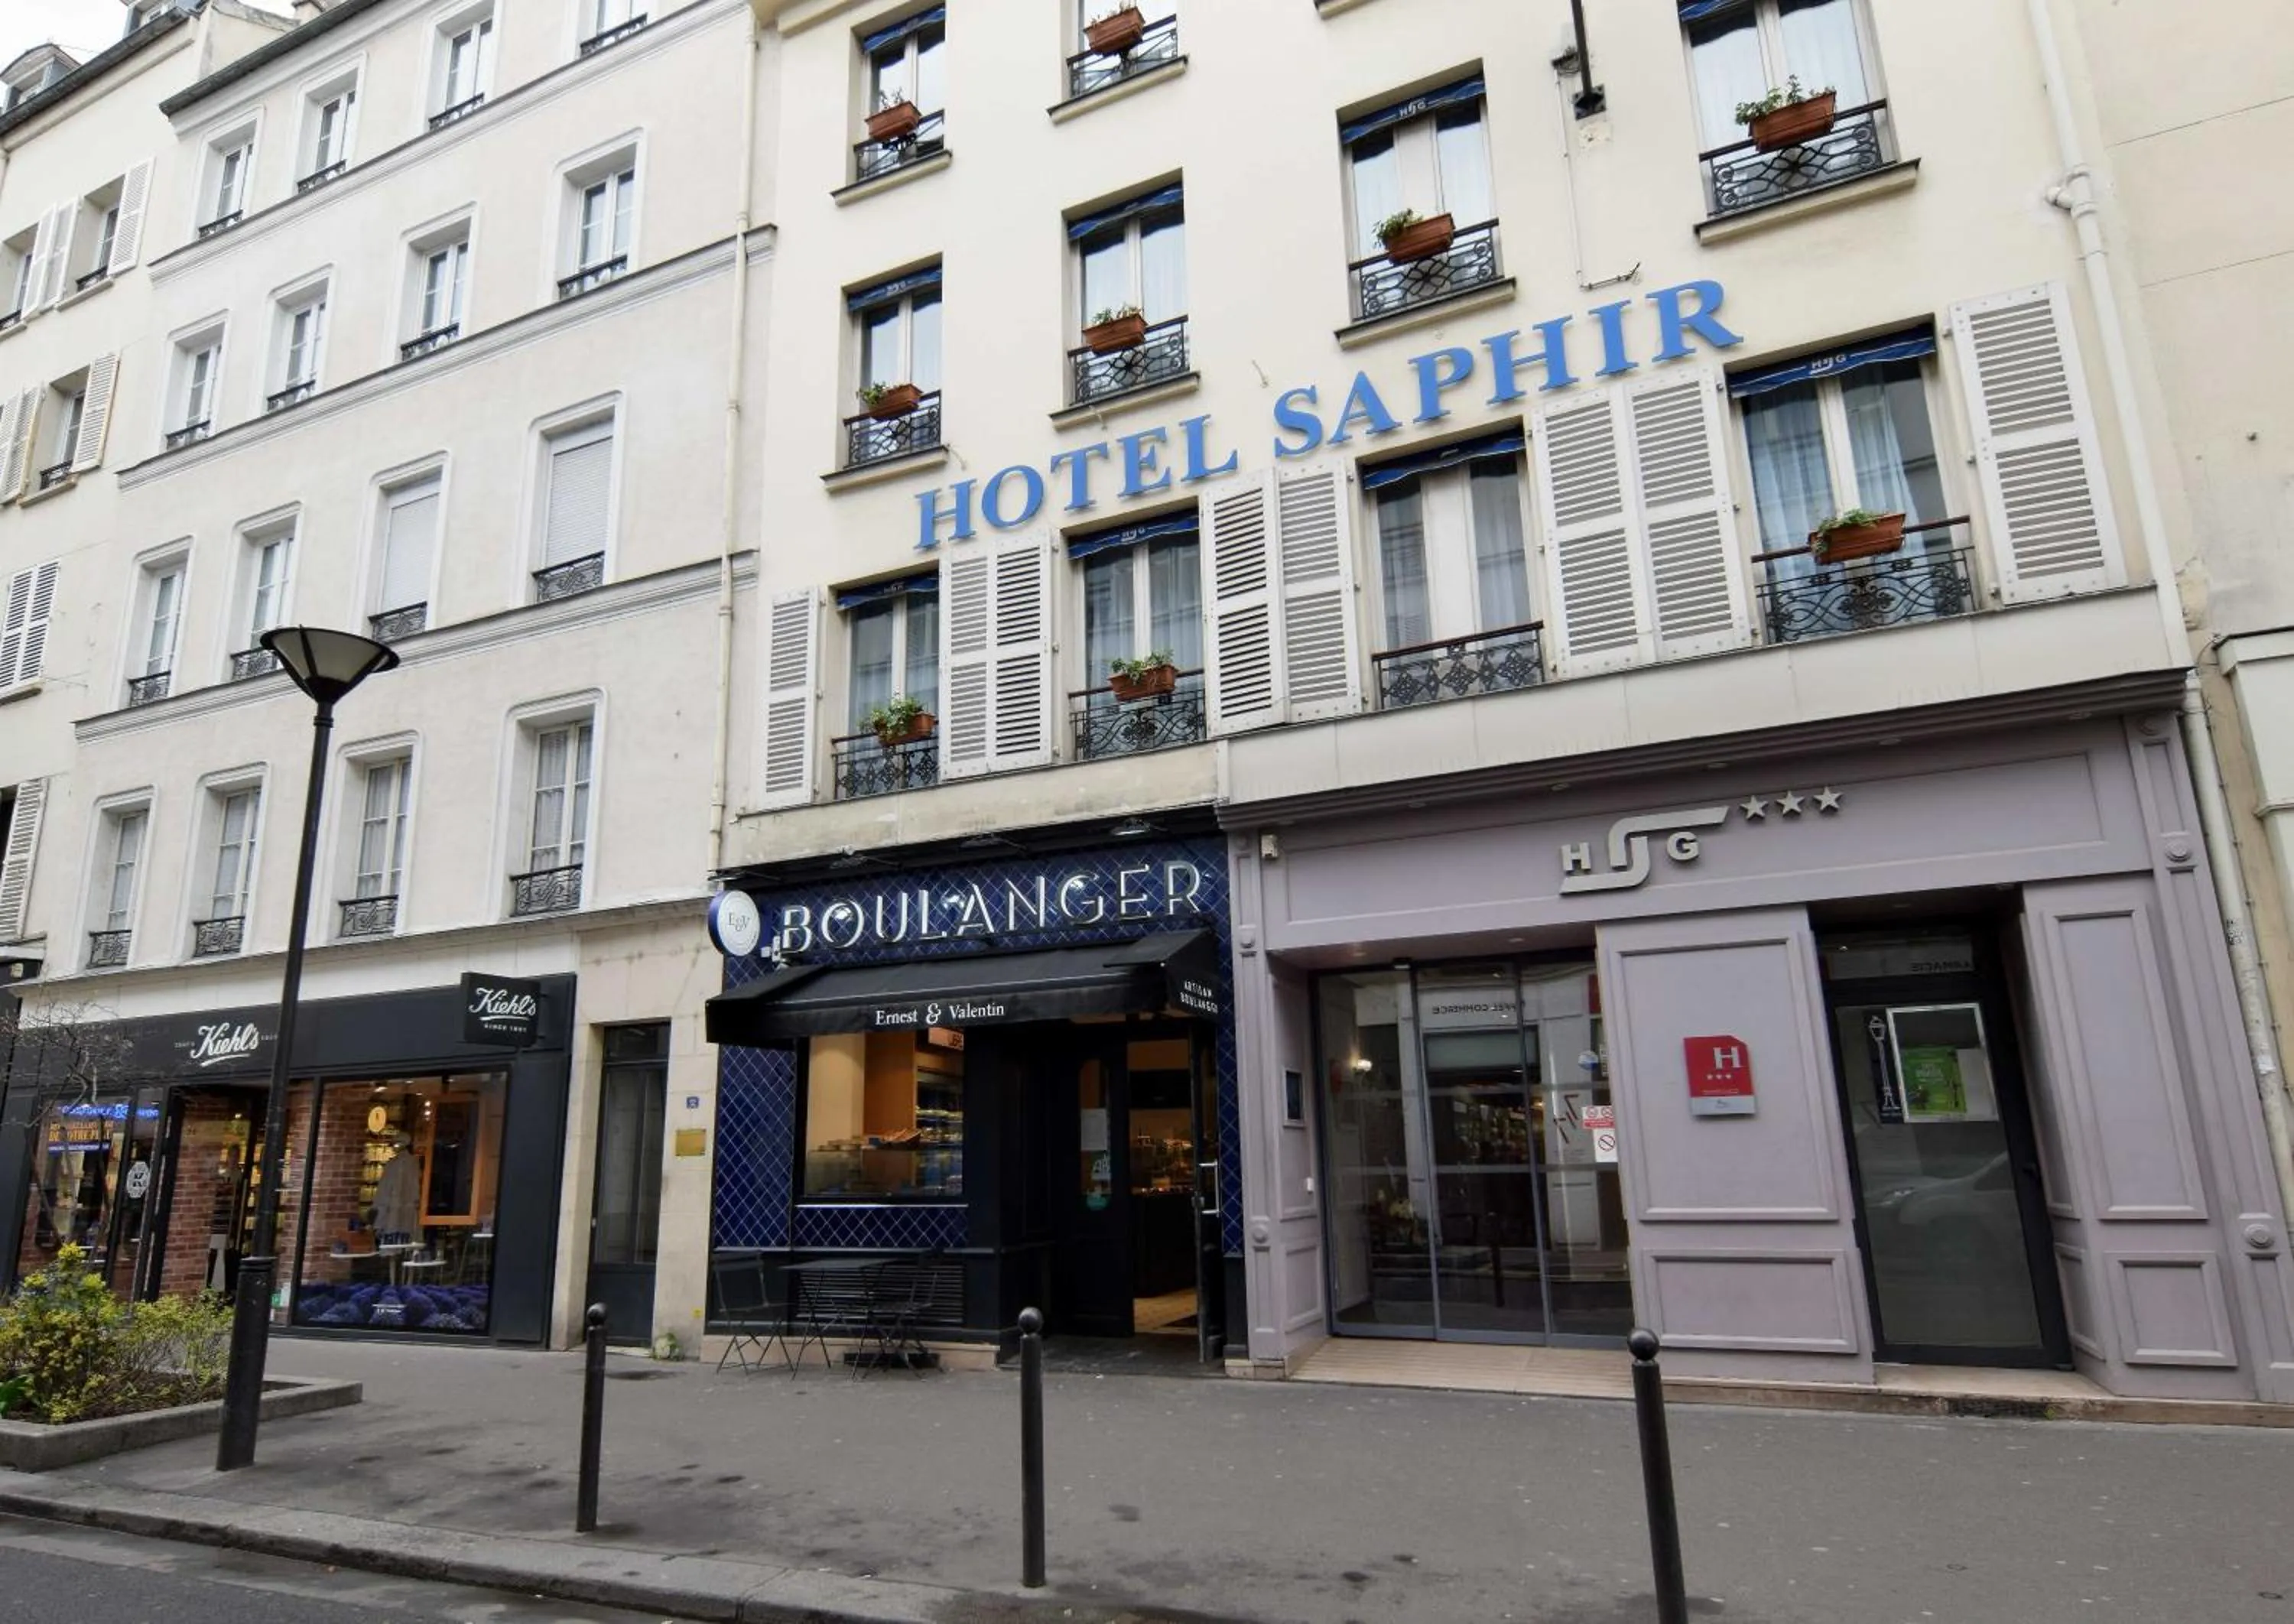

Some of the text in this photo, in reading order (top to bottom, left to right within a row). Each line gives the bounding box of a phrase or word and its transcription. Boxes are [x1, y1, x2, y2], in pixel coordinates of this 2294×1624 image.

[913, 278, 1745, 550] HOTEL SAPHIR
[781, 859, 1201, 953] BOULANGER
[468, 986, 537, 1016] Kiehl's
[875, 1002, 1005, 1025] Ernest & Valentin
[190, 1021, 260, 1060] Kiehl's
[1713, 1046, 1744, 1070] H
